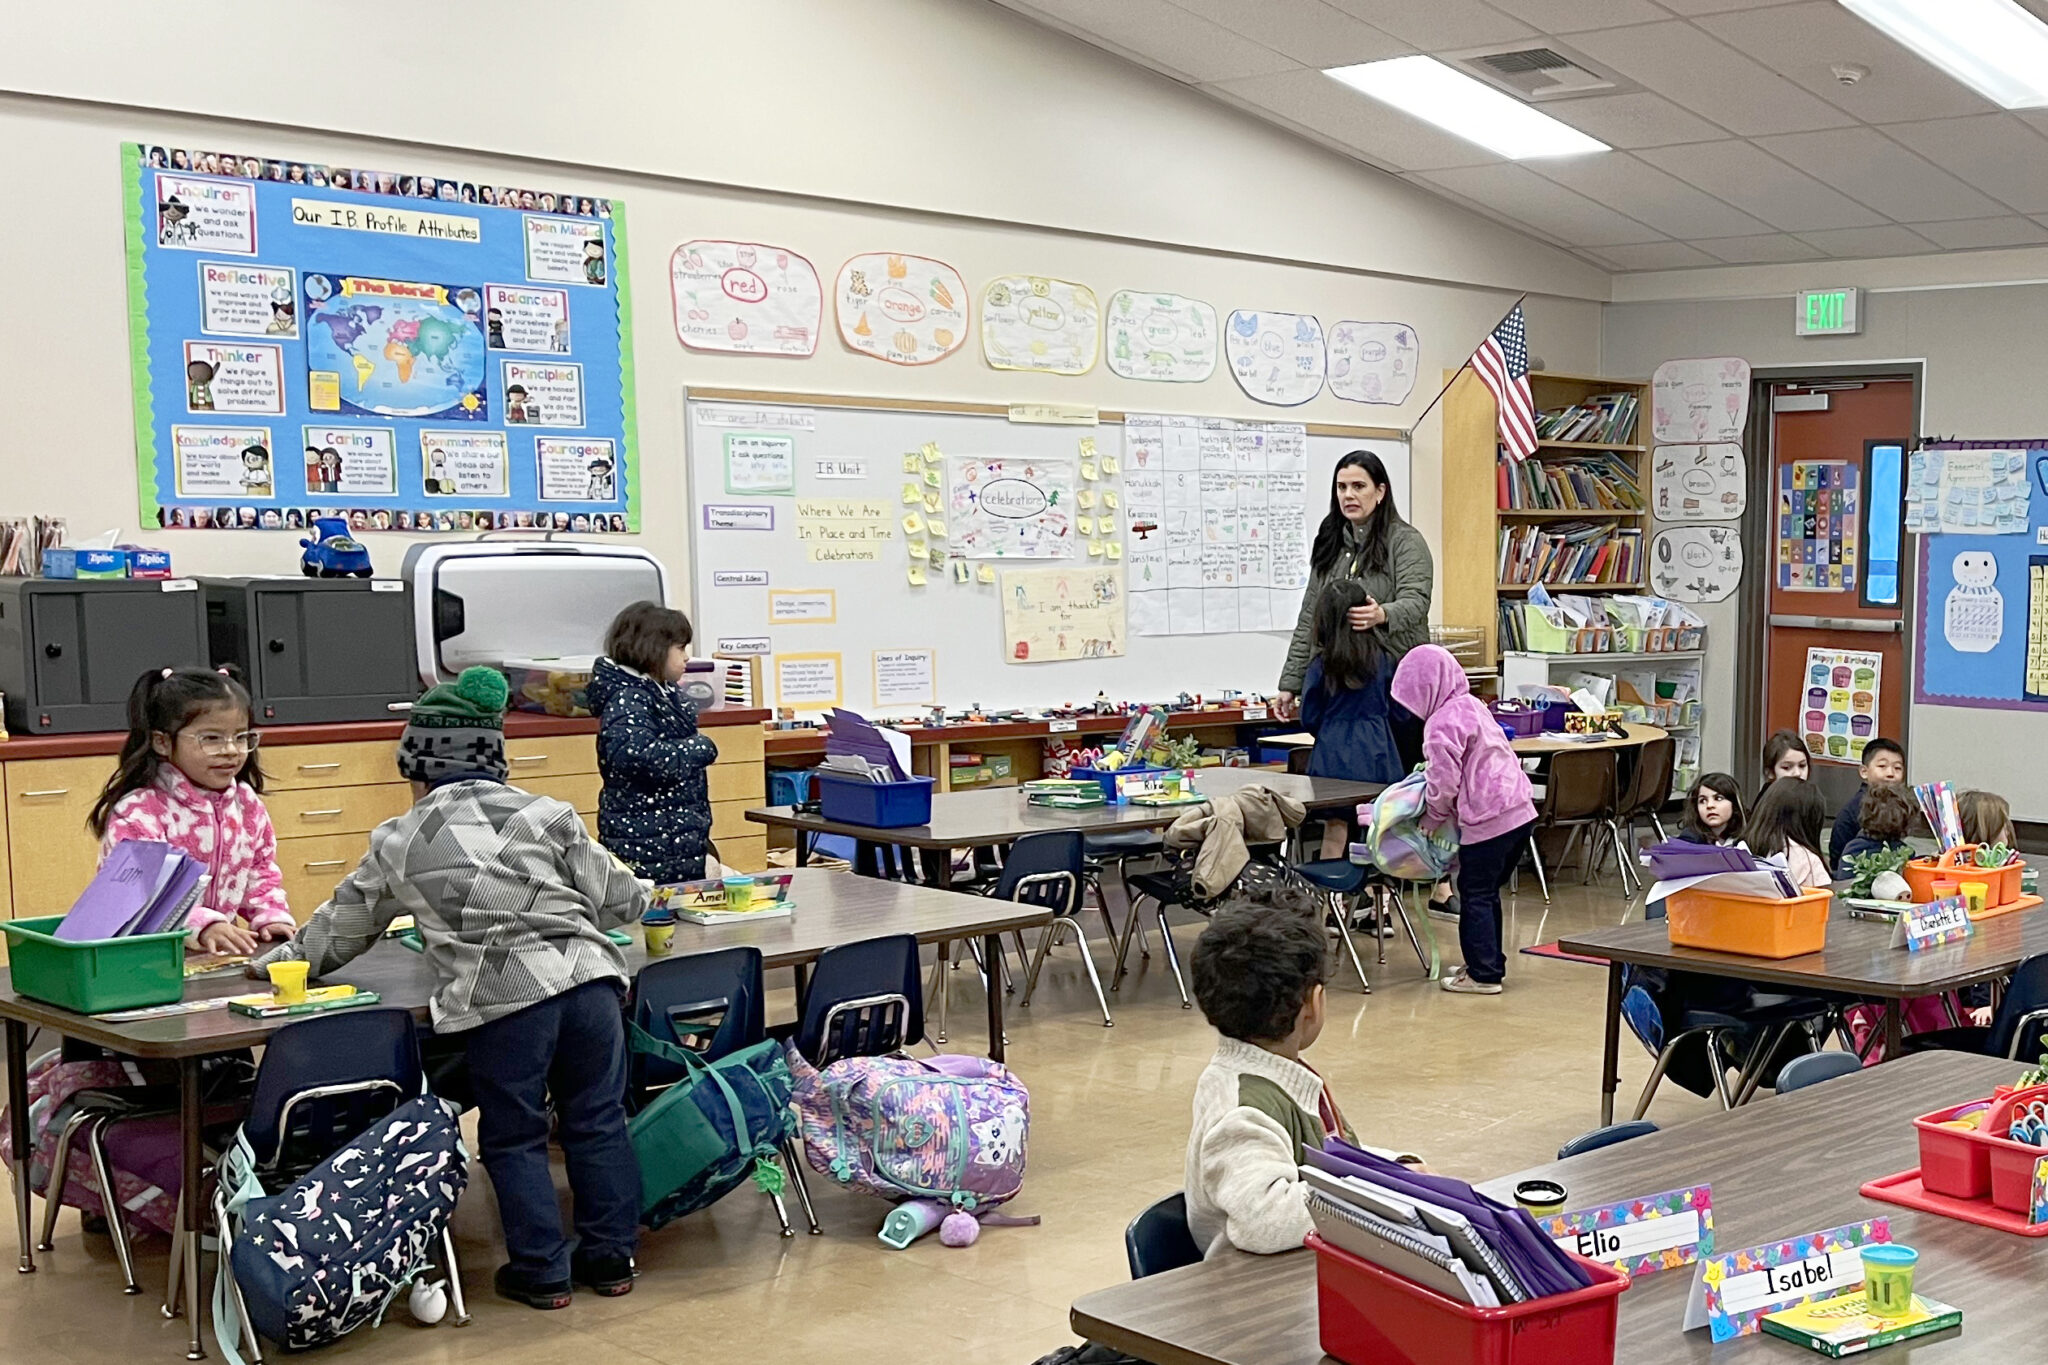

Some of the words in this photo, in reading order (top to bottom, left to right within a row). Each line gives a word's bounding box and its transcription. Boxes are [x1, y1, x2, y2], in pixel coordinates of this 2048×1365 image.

[210, 208, 247, 217] wonder
[203, 217, 221, 226] and
[294, 205, 321, 223] Our
[366, 212, 407, 233] Profile
[418, 219, 477, 240] Attributes
[207, 268, 287, 287] Reflective
[352, 280, 385, 293] The
[389, 282, 435, 299] World
[730, 278, 756, 293] red
[498, 290, 558, 307] Balanced
[884, 299, 921, 316] orange
[1807, 293, 1846, 330] EXIT
[206, 347, 263, 363] Thinker
[240, 368, 266, 377] figure
[511, 366, 574, 382] Principled
[219, 377, 245, 387] things
[247, 379, 262, 387] out
[217, 387, 238, 395] solve
[241, 388, 276, 396] difficult
[541, 412, 558, 421] right
[176, 435, 268, 449] Knowledgeable
[326, 432, 373, 449] Caring
[422, 435, 505, 448] Communicator
[200, 461, 221, 469] world
[479, 462, 494, 470] and
[838, 461, 861, 474] Unit
[458, 471, 481, 480] listen
[1178, 474, 1184, 487] 8
[710, 508, 768, 518] Transdisciplinary
[797, 503, 831, 517] Where
[839, 504, 854, 517] We
[862, 505, 880, 517] Are
[1180, 510, 1187, 528] 7
[799, 526, 812, 539] In
[820, 526, 845, 539] Place
[848, 526, 865, 539] and
[870, 526, 892, 539] Time
[90, 552, 114, 564] Ziploc
[140, 553, 165, 566] Ziploc
[815, 548, 874, 560] Celebrations
[1687, 551, 1706, 559] black
[1040, 602, 1045, 613] I
[720, 642, 733, 650] Key
[1812, 653, 1834, 665] Happy
[1844, 654, 1876, 668] Birthday
[1577, 1230, 1621, 1258] Elio
[1762, 1253, 1834, 1296] Isabel
